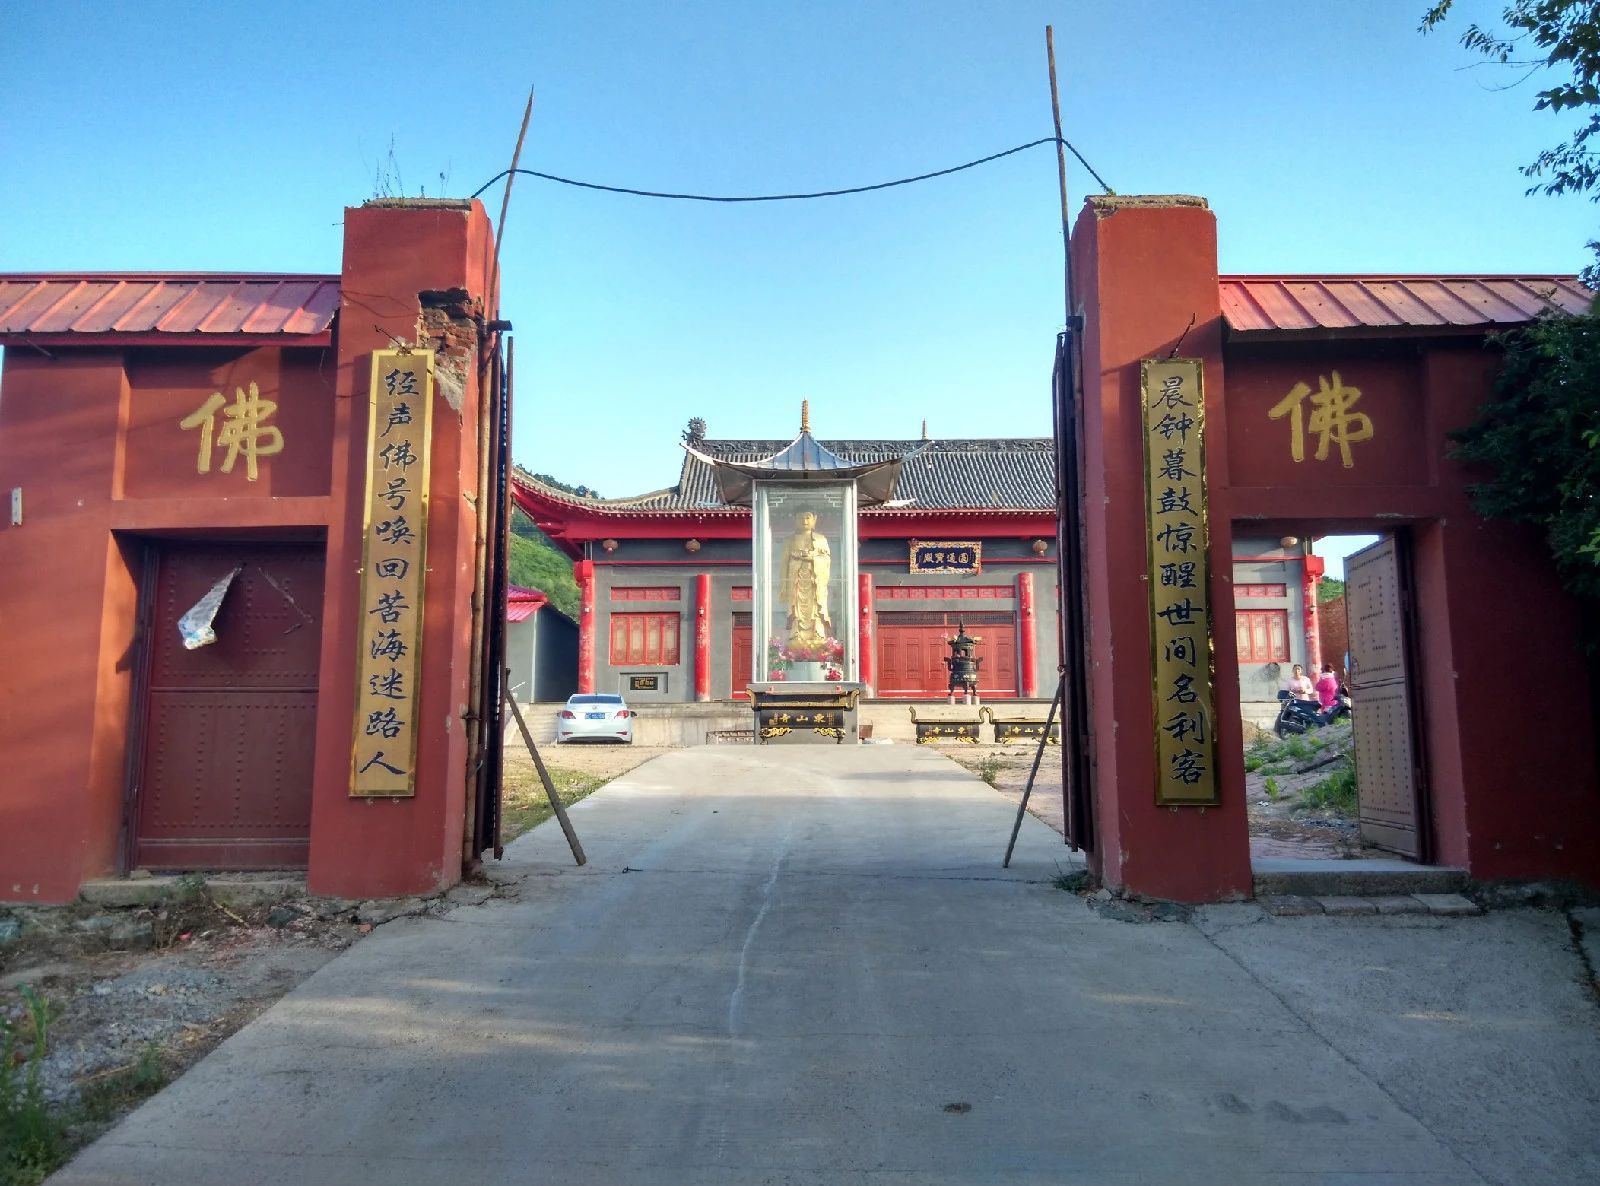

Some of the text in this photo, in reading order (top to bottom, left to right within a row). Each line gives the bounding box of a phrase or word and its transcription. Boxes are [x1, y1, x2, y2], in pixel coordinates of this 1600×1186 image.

[180, 380, 284, 482] 佛
[1268, 369, 1374, 469] 佛
[358, 367, 420, 775] 经声佛号唤回苦海迷路人
[1151, 374, 1207, 785] 晨钟暮鼓惊醒世间名利客
